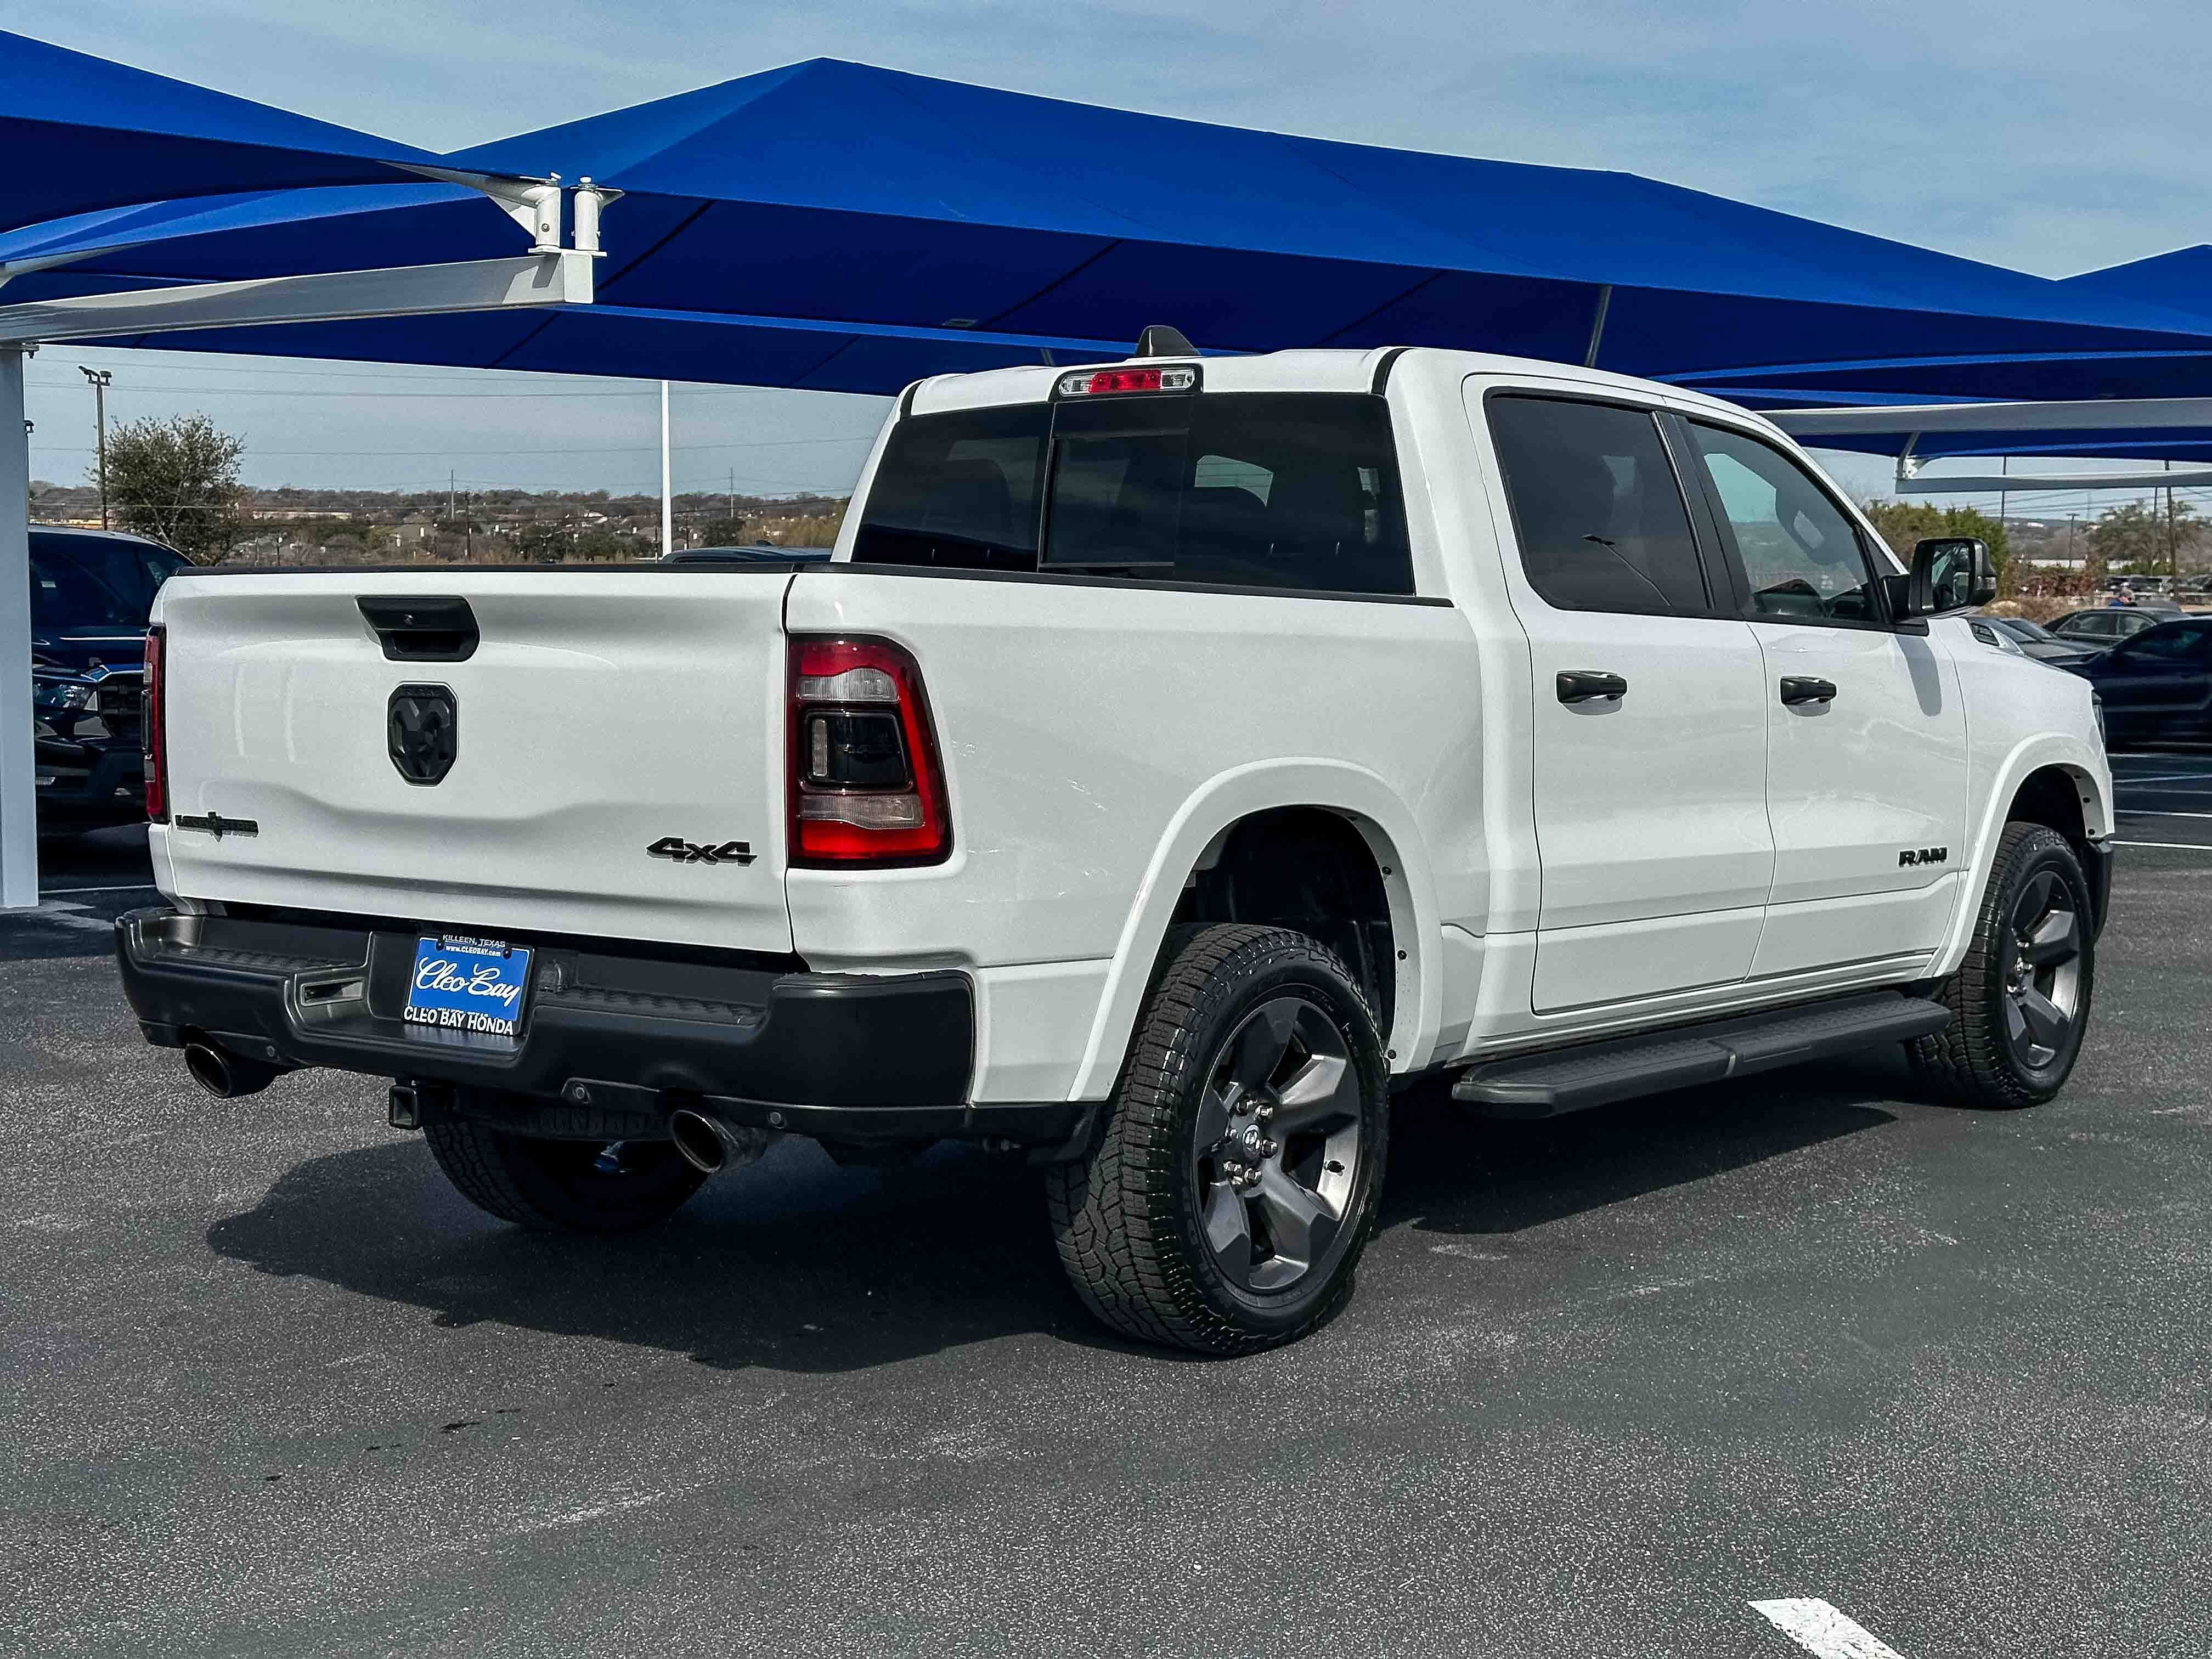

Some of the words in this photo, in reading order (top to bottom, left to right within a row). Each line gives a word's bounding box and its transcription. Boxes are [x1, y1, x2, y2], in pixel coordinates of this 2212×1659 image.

[1898, 847, 1948, 867] RAM
[442, 934, 477, 945] KILLEEN,
[478, 939, 506, 947] TEXAS
[415, 957, 469, 992] Cleo
[467, 963, 521, 1007] Bay
[404, 1006, 437, 1023] CLEO
[439, 1011, 465, 1028] BAY
[467, 1014, 514, 1035] HONDA
